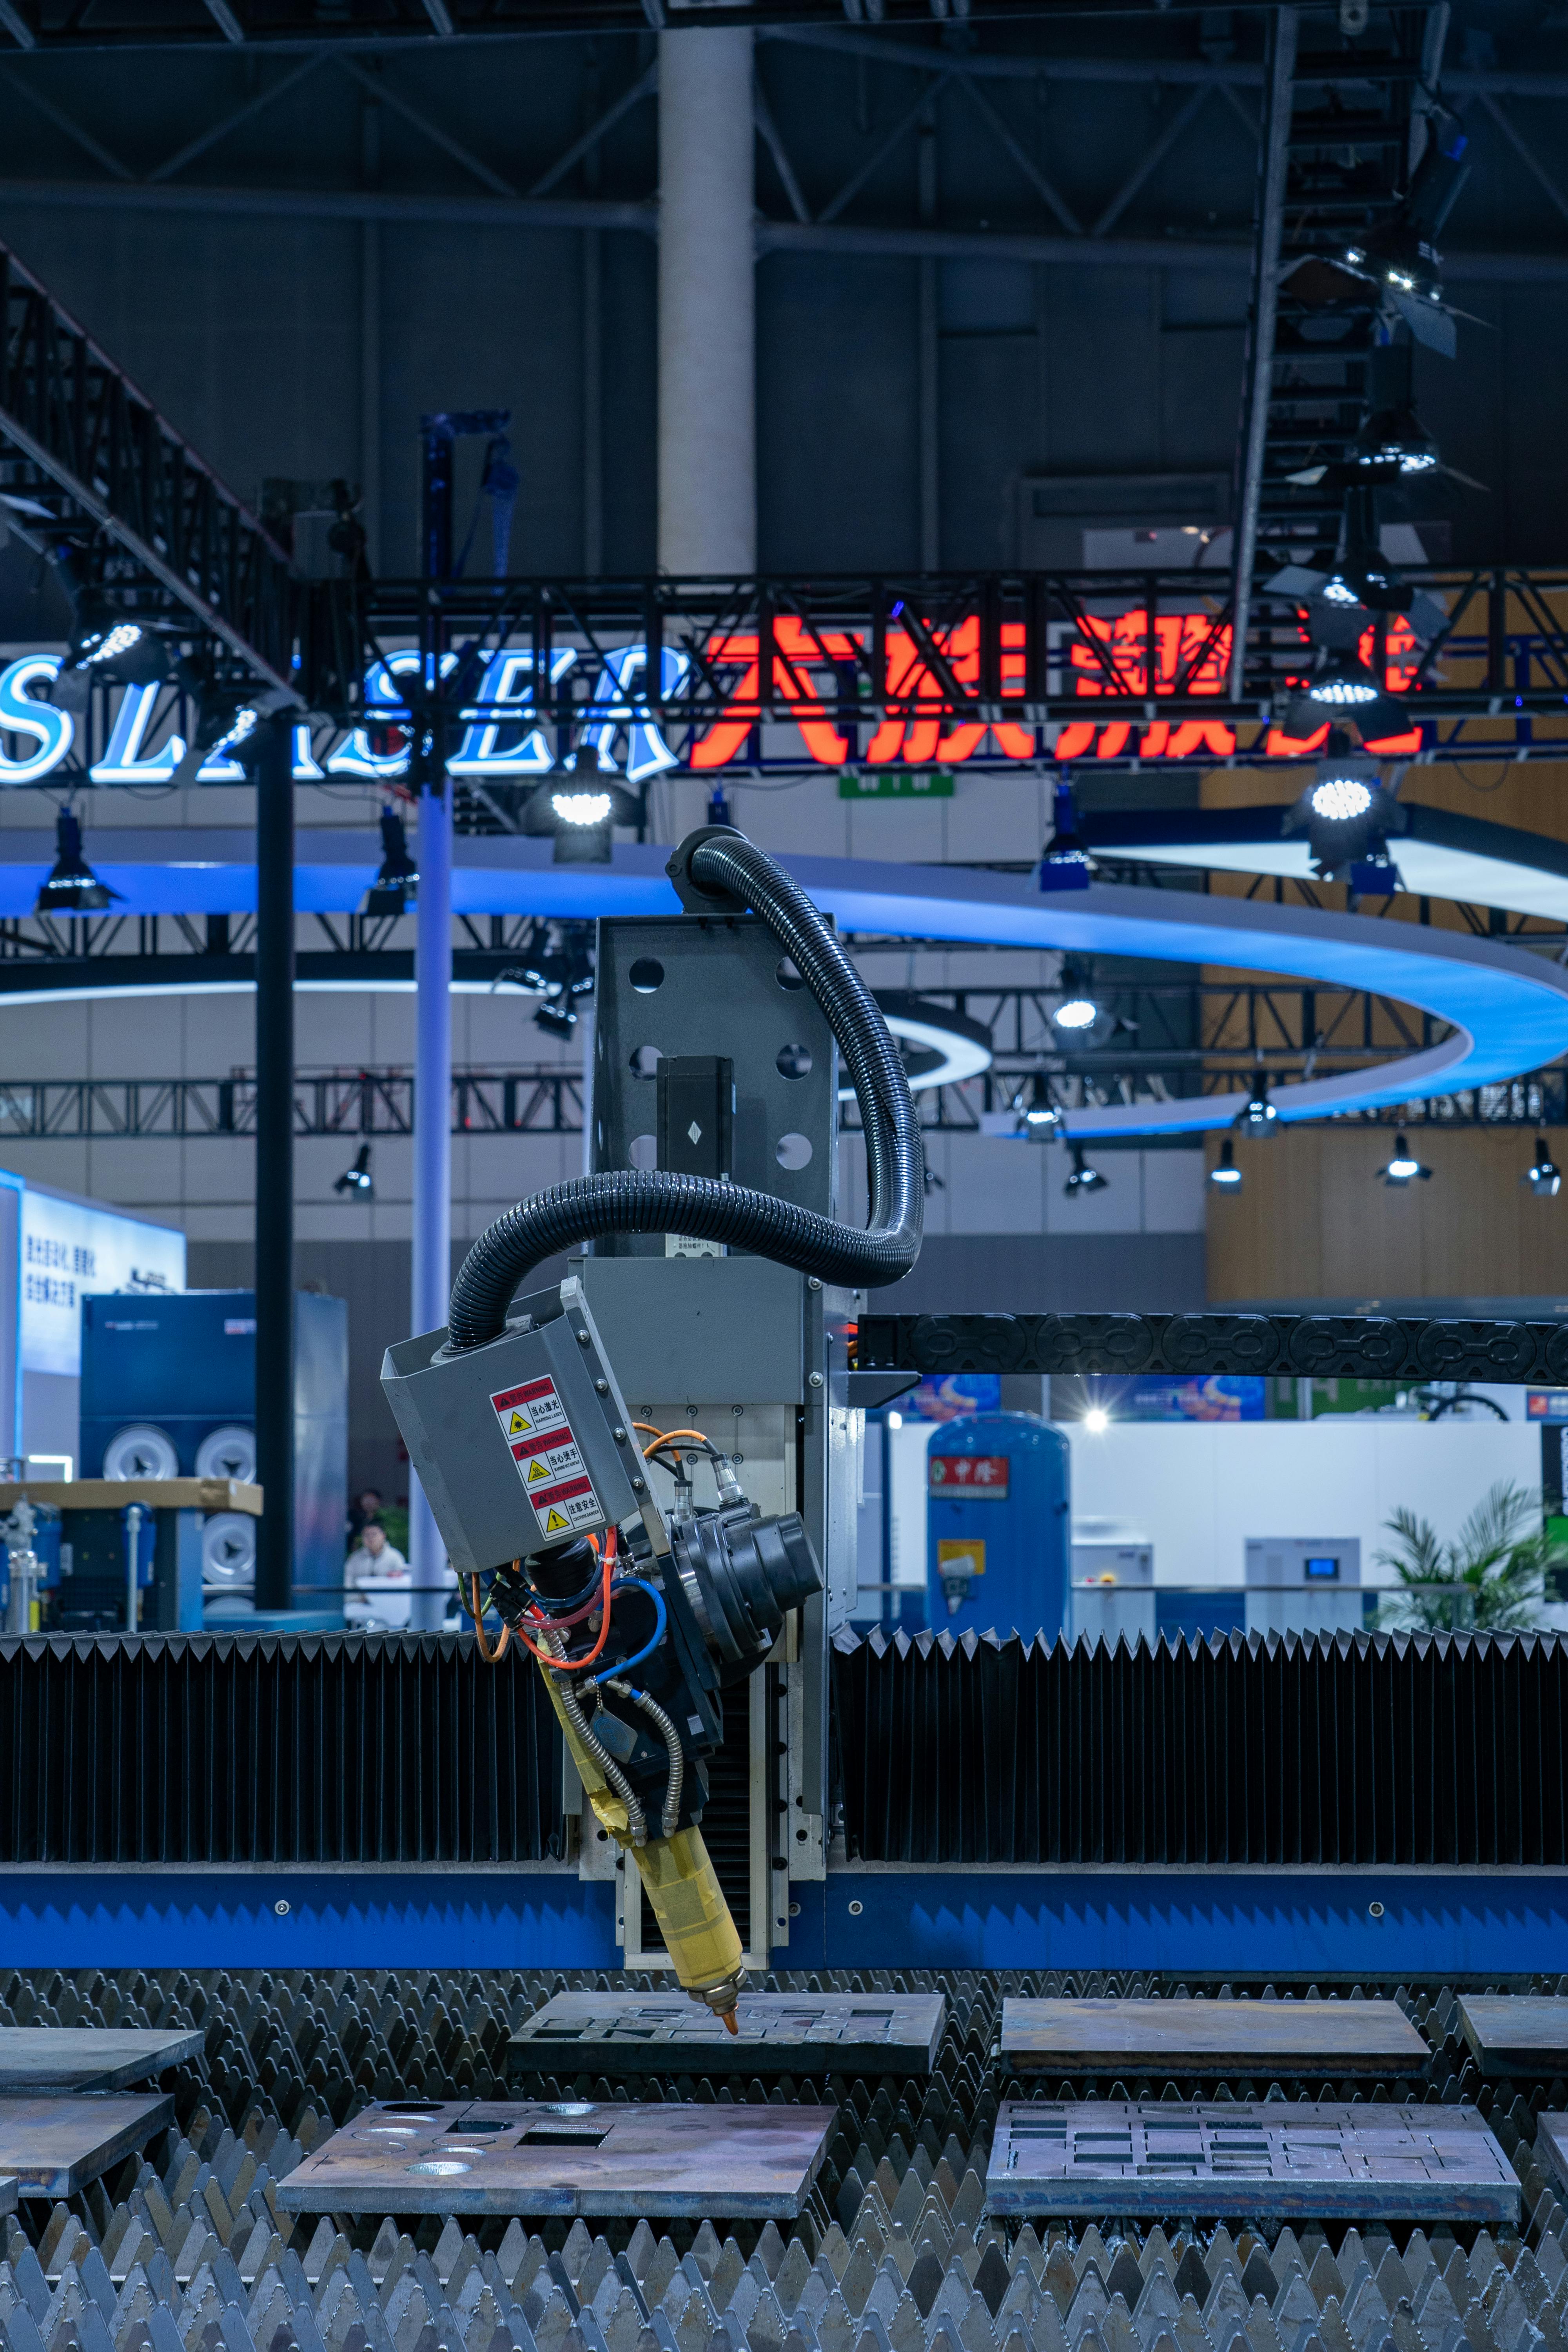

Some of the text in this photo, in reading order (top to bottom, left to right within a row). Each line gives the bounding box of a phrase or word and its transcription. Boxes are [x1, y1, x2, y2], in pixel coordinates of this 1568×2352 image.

[509, 1383, 549, 1403] 警告 WARNING
[531, 1399, 559, 1417] 当心激光
[535, 1415, 552, 1424] WARNING
[529, 1432, 568, 1452] 警告 WARNING
[550, 1448, 577, 1466] 当心烫手
[547, 1481, 587, 1502] 警告 WARNING
[568, 1497, 596, 1514] 注意安全
[573, 1514, 587, 1522] CAUTION
